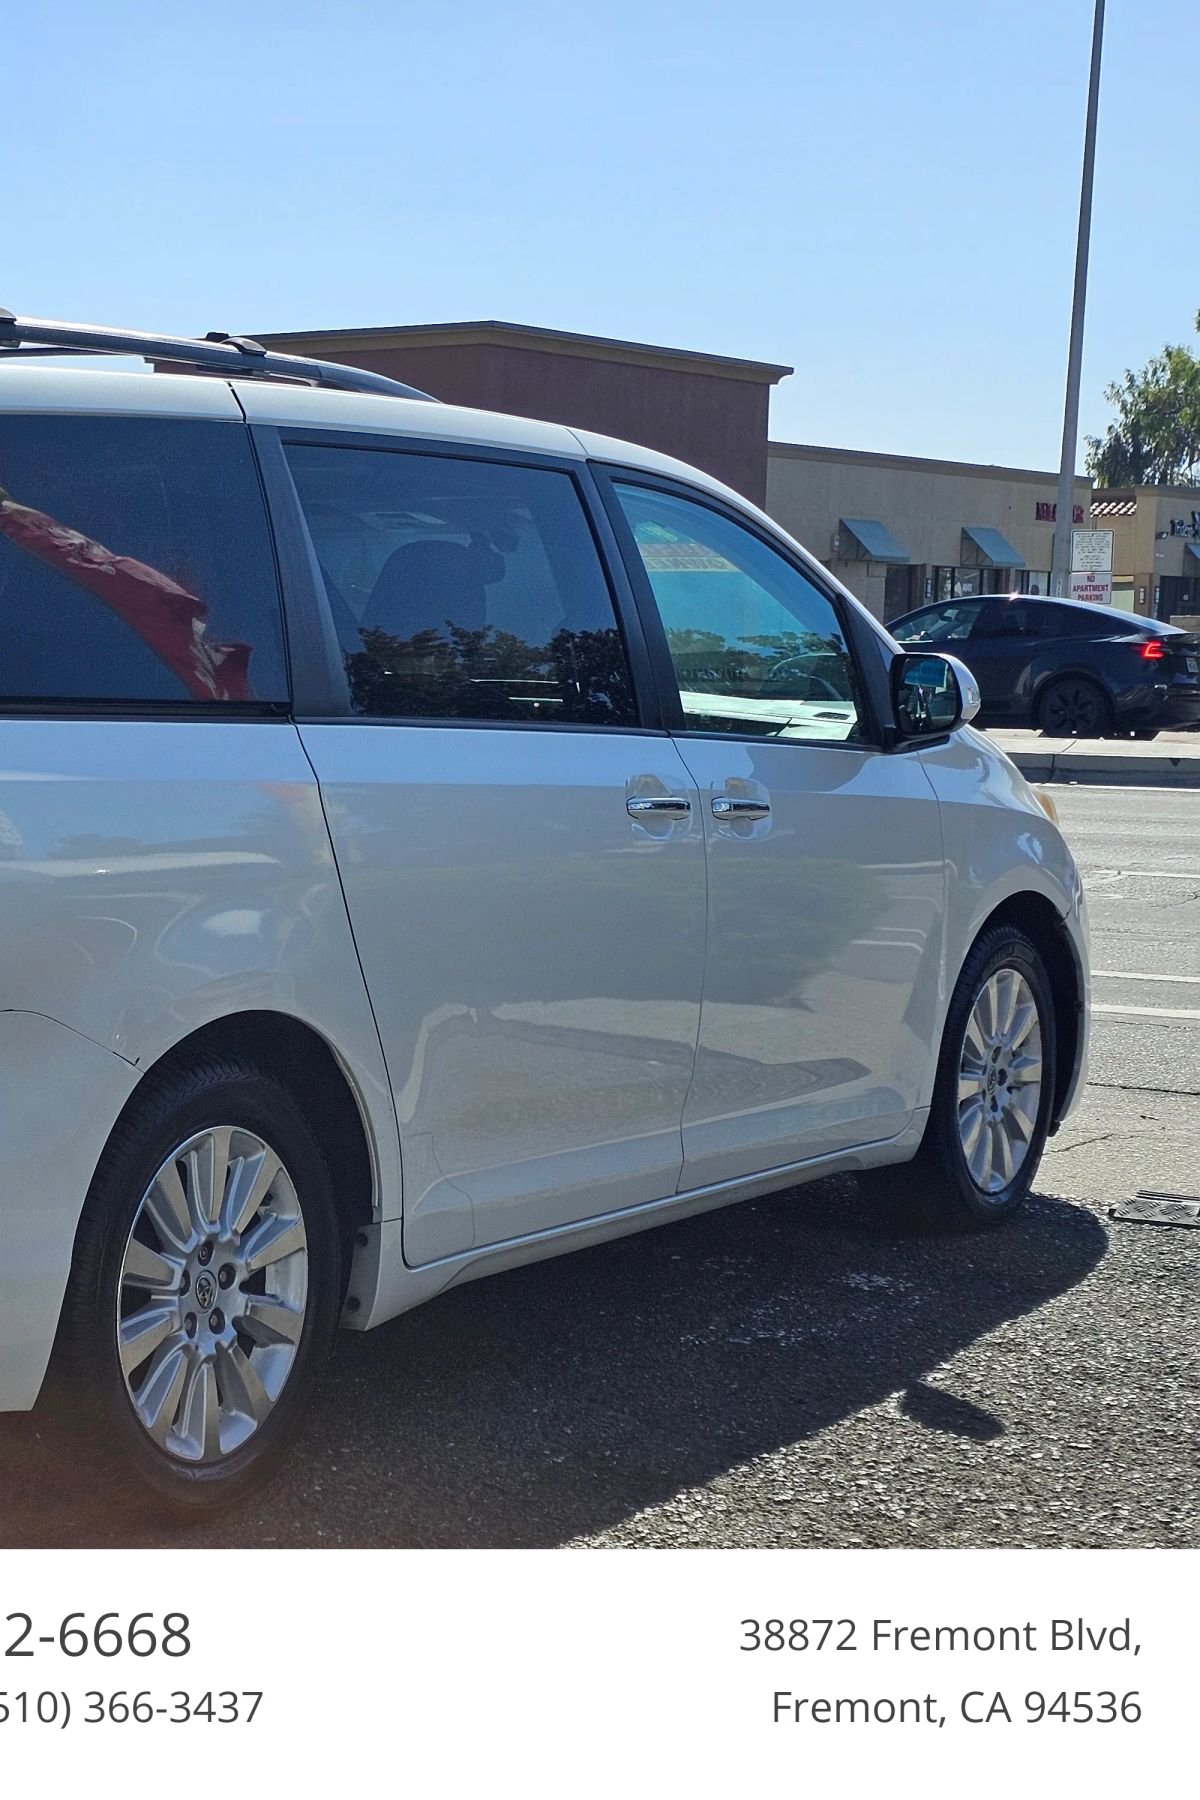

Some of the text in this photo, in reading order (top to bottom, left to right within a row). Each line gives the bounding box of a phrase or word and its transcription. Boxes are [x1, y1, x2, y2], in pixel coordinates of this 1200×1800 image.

[1086, 575, 1096, 583] NO
[1072, 584, 1109, 592] APARTMENT
[1077, 593, 1104, 601] PARKING
